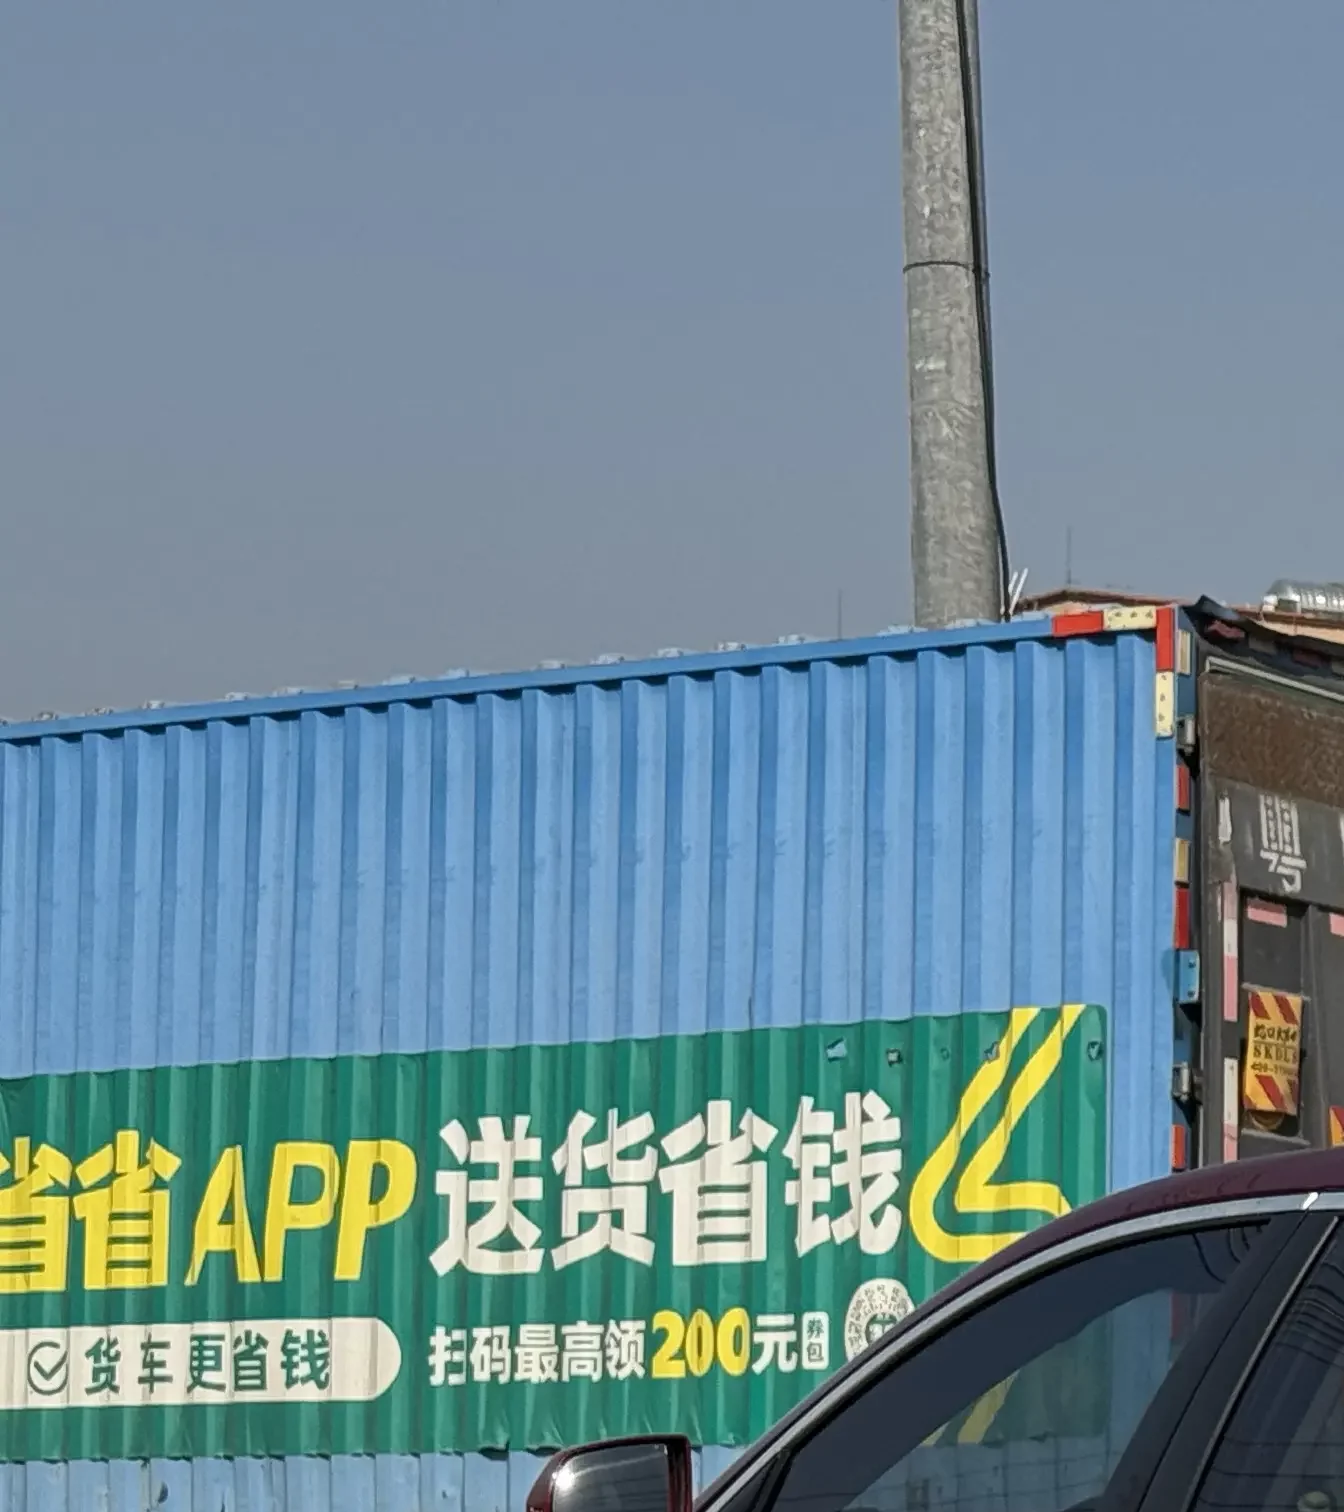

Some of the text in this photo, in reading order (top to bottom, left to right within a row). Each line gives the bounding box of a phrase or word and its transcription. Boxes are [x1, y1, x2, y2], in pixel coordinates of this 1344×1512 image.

[428, 1089, 902, 1277] 送货省钱
[84, 1328, 332, 1396] 货车更省钱
